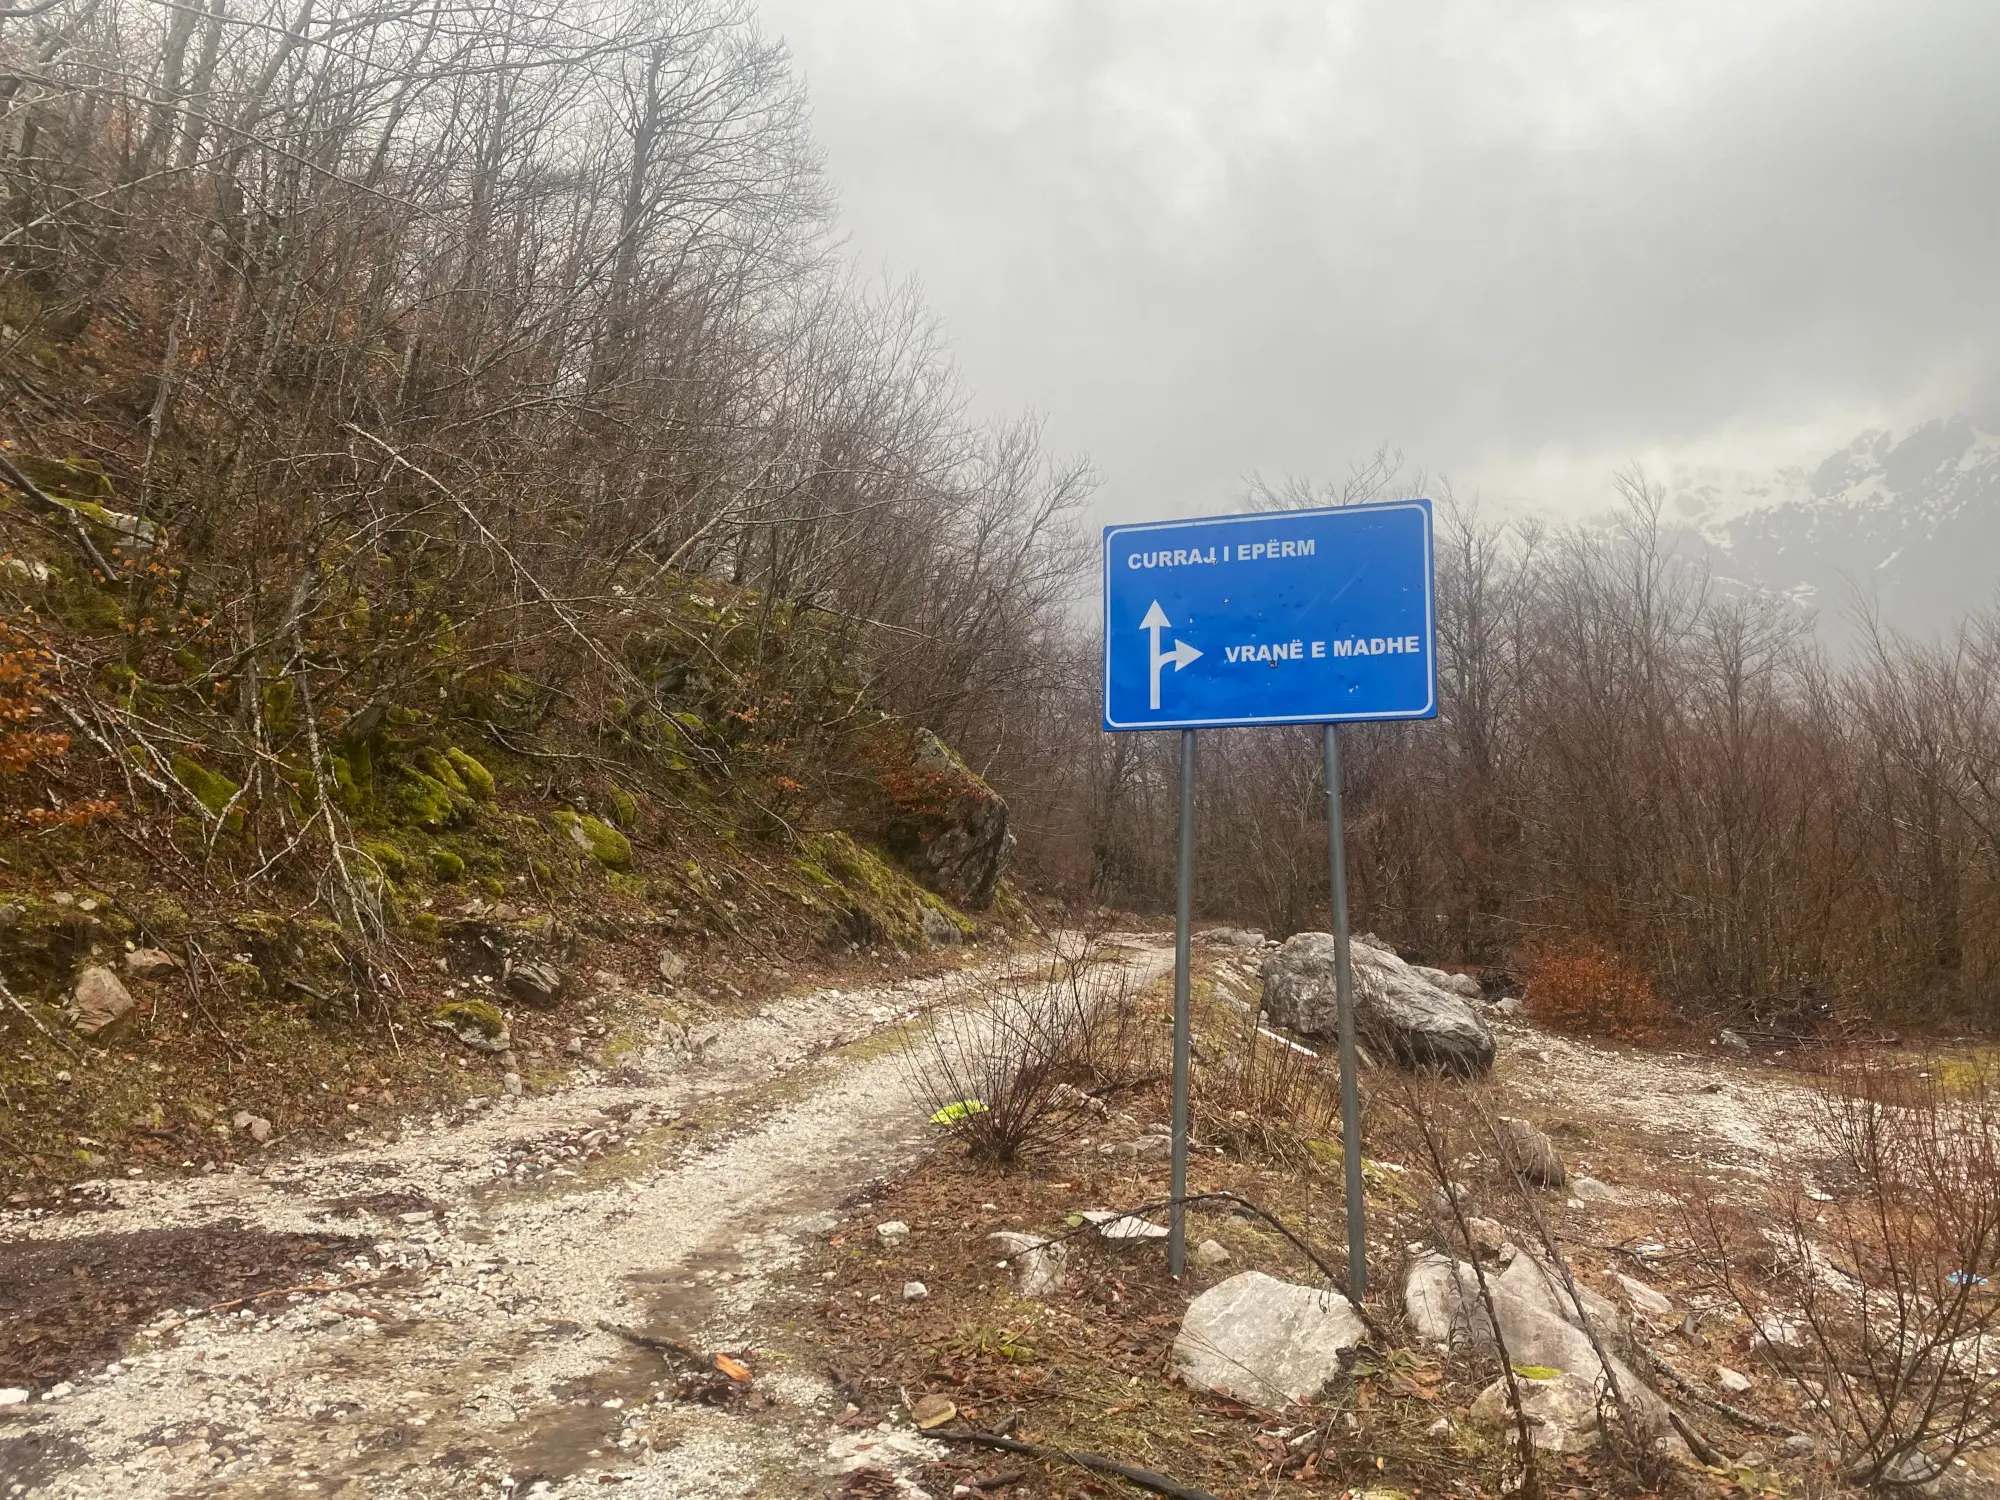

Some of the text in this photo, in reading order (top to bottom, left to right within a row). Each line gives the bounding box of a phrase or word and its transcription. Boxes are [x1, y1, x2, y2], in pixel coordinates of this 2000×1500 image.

[1127, 539, 1316, 570] CURRAJ I EPËRM
[1224, 635, 1420, 663] VRANË E MADHE
